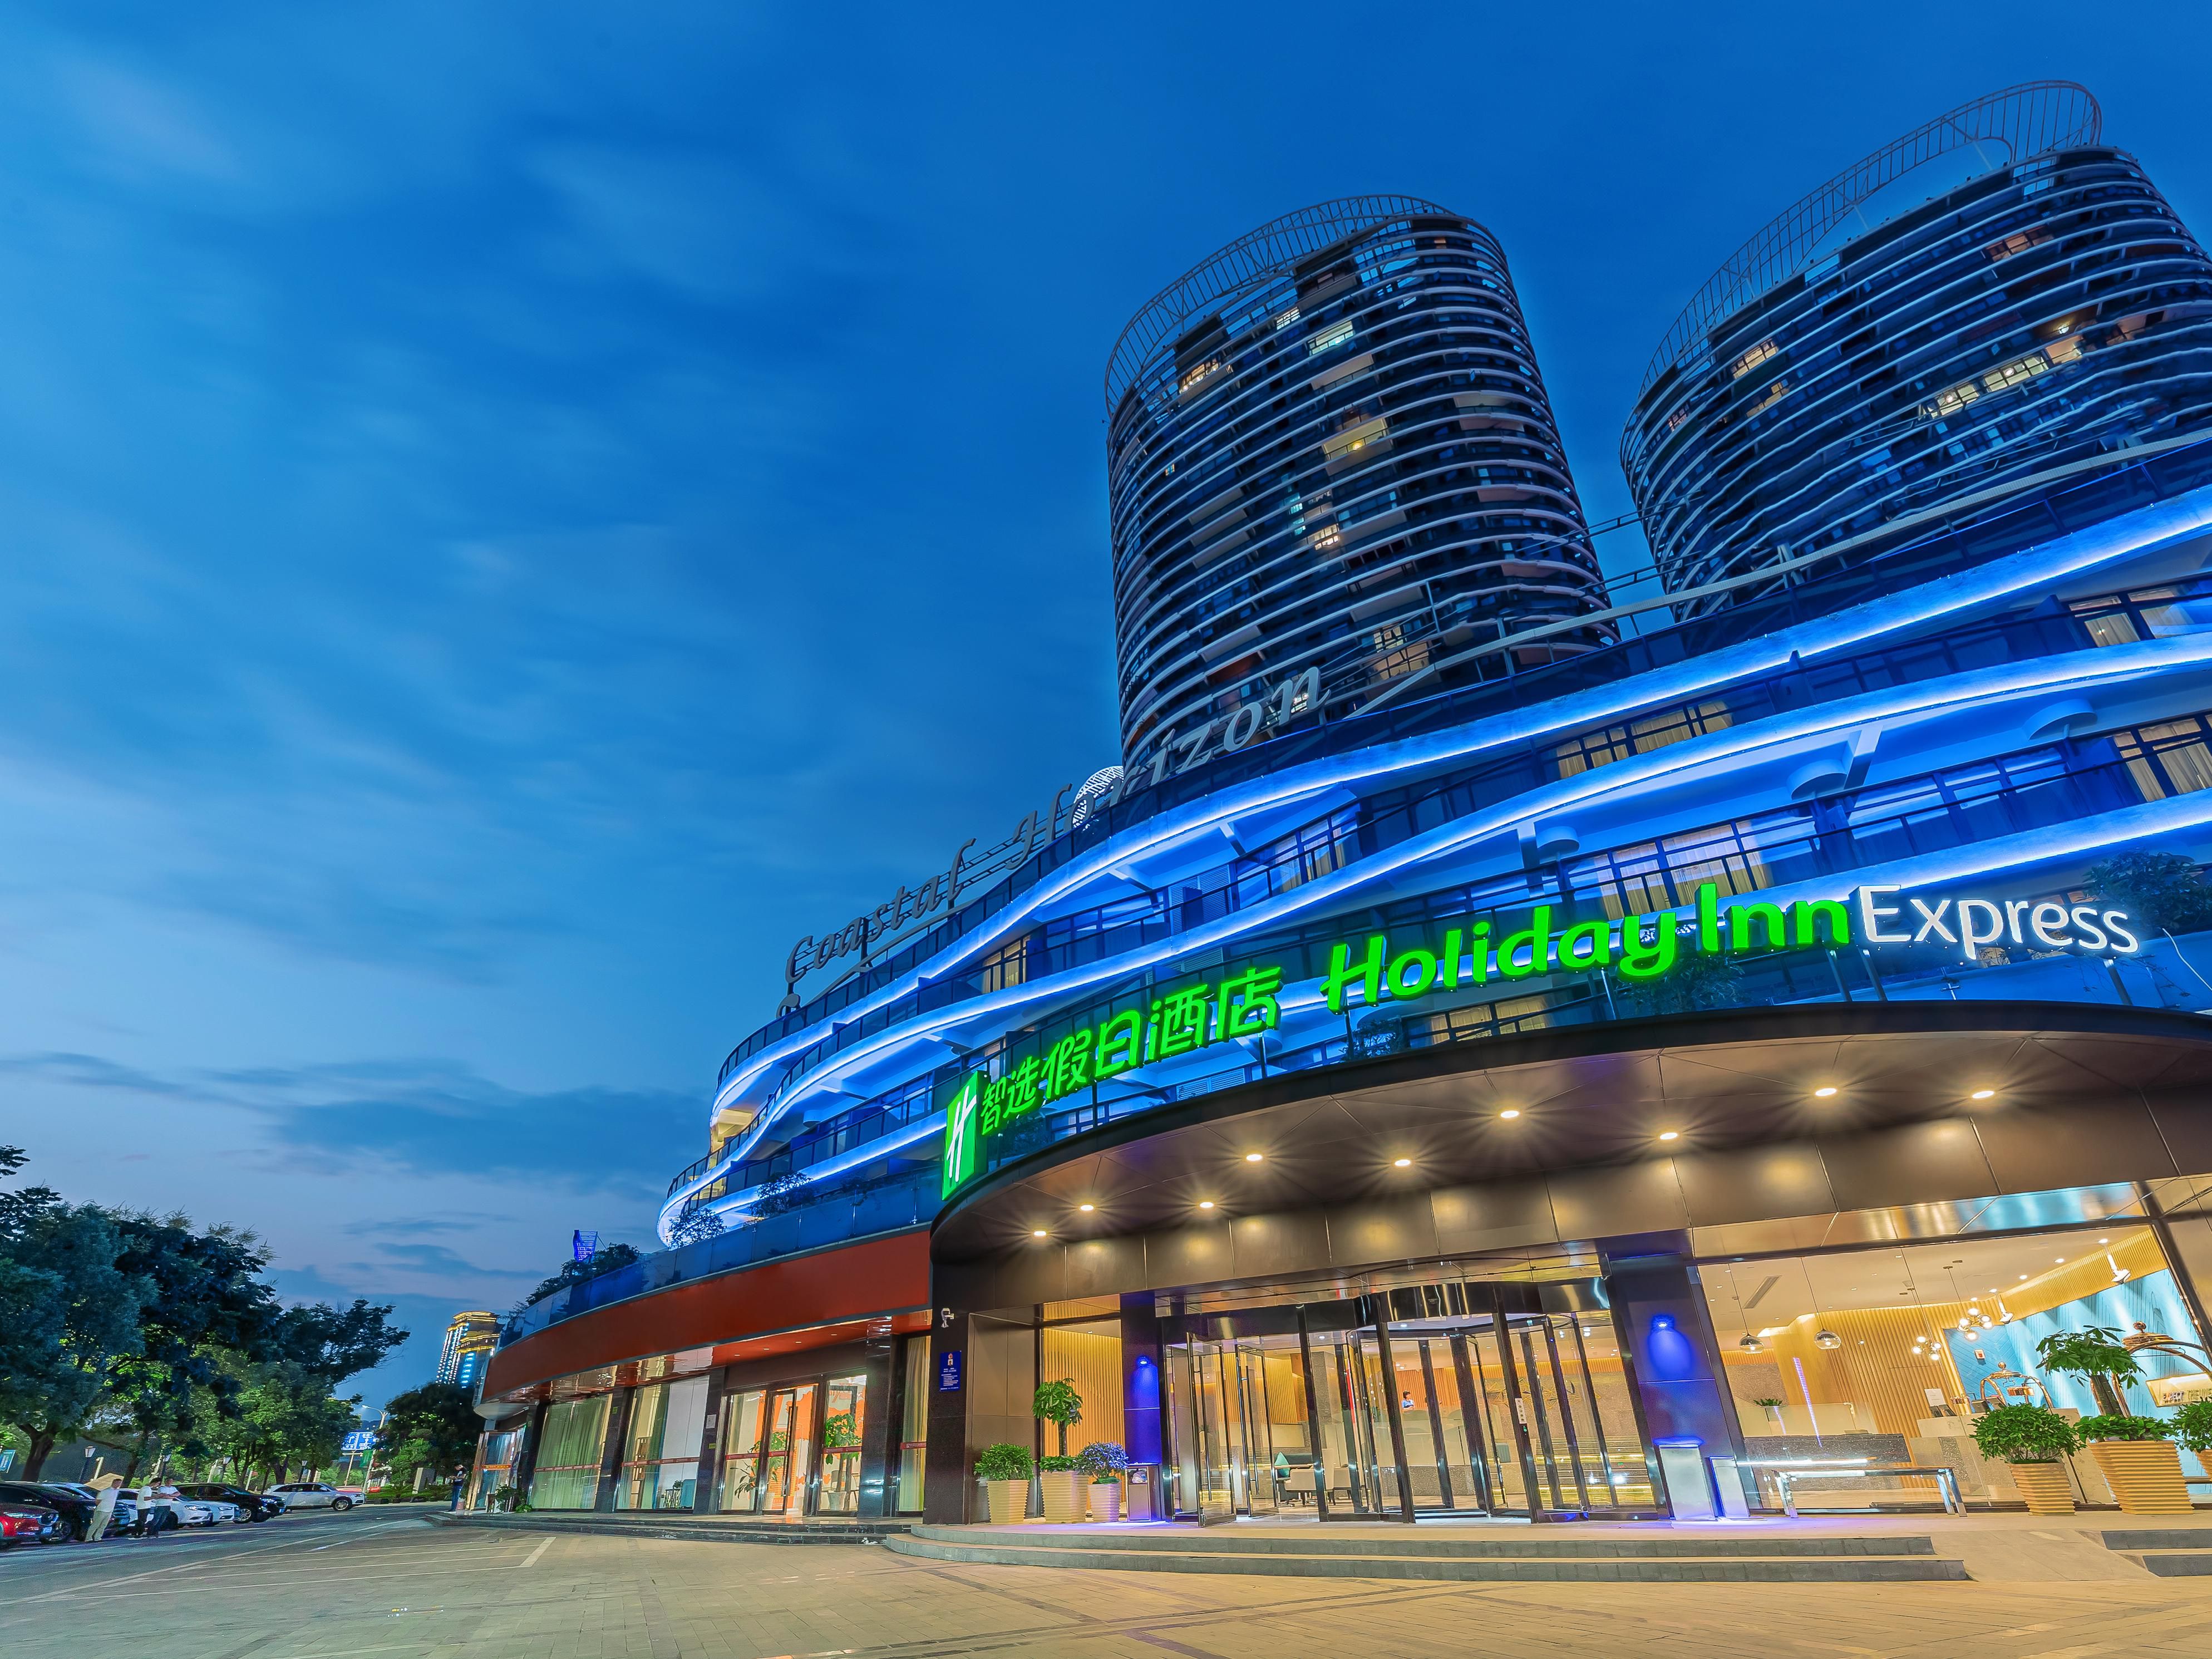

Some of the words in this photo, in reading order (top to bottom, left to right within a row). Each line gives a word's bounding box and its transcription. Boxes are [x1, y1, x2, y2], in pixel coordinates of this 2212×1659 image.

[785, 838, 977, 984] Coastal
[1004, 666, 1331, 870] Horizon
[1319, 905, 1677, 1013] Holiday
[1694, 883, 1850, 952] Inn
[1850, 884, 2139, 961] Express
[981, 967, 1282, 1135] 智选假日酒店
